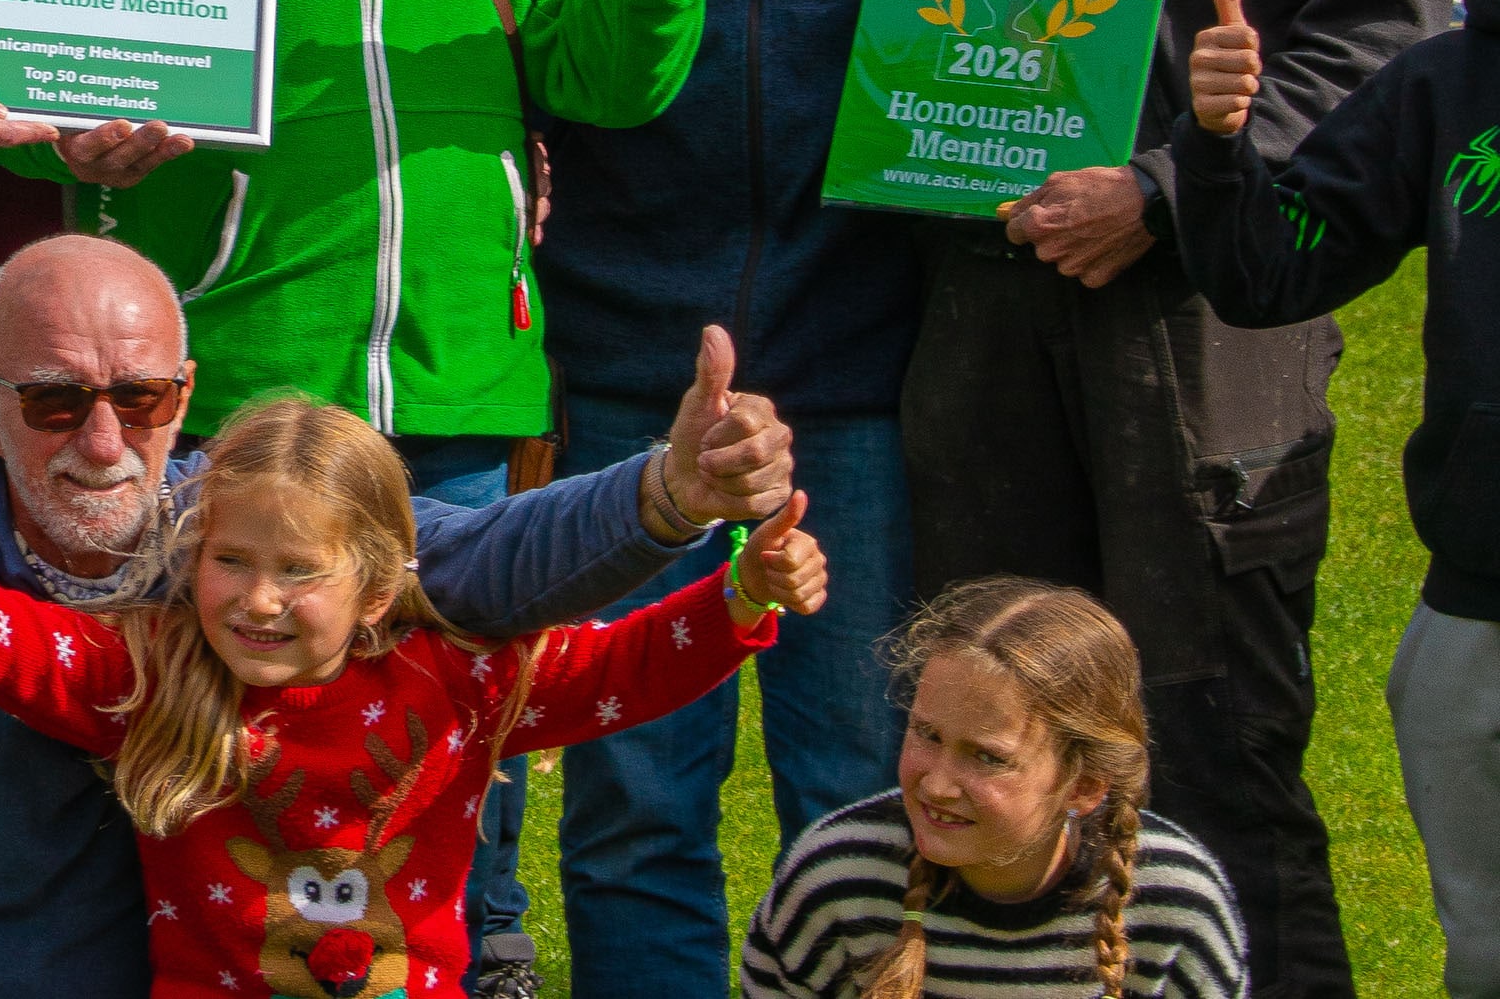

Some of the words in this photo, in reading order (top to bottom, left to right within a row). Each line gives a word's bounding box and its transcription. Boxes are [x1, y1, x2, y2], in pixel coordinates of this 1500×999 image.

[88, 45, 212, 69] Heksenheuvel
[948, 42, 1043, 81] 2026
[23, 66, 54, 83] Top
[56, 70, 77, 84] 50
[79, 74, 160, 91] campsites
[26, 87, 57, 102] The
[59, 90, 158, 111] Netherlands
[886, 90, 1085, 139] Honourable
[906, 128, 1048, 172] Mention
